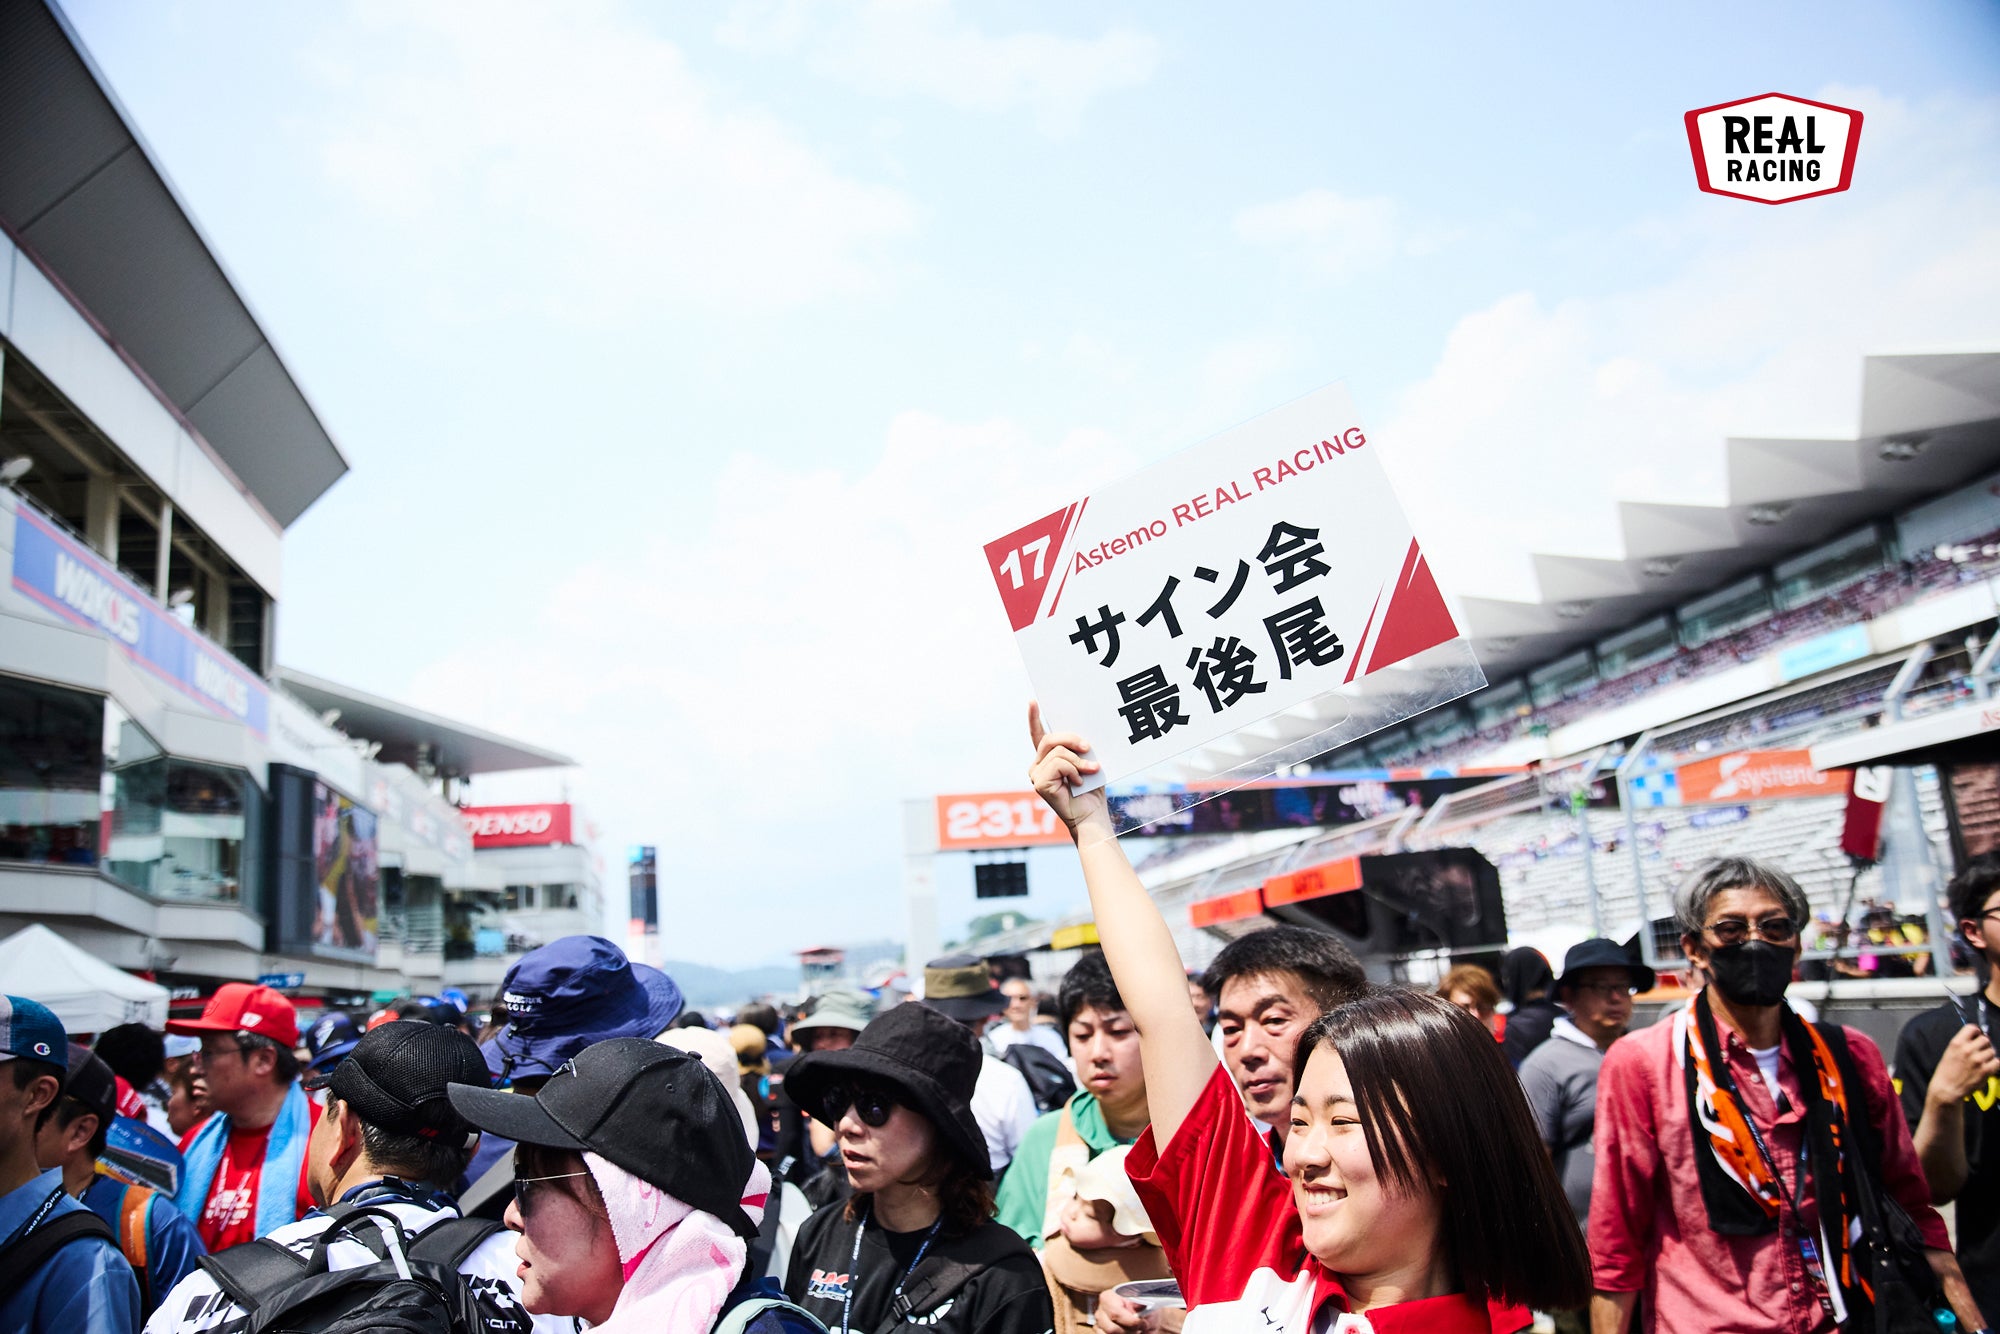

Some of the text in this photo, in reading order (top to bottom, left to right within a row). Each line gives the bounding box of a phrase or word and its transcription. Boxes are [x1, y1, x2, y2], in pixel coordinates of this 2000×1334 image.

[999, 534, 1051, 591] 17
[1075, 427, 1367, 576] Astemo REAL RACING
[1068, 520, 1332, 668] サイン会
[1116, 595, 1345, 745] 最後尾
[463, 810, 552, 838] DENSO
